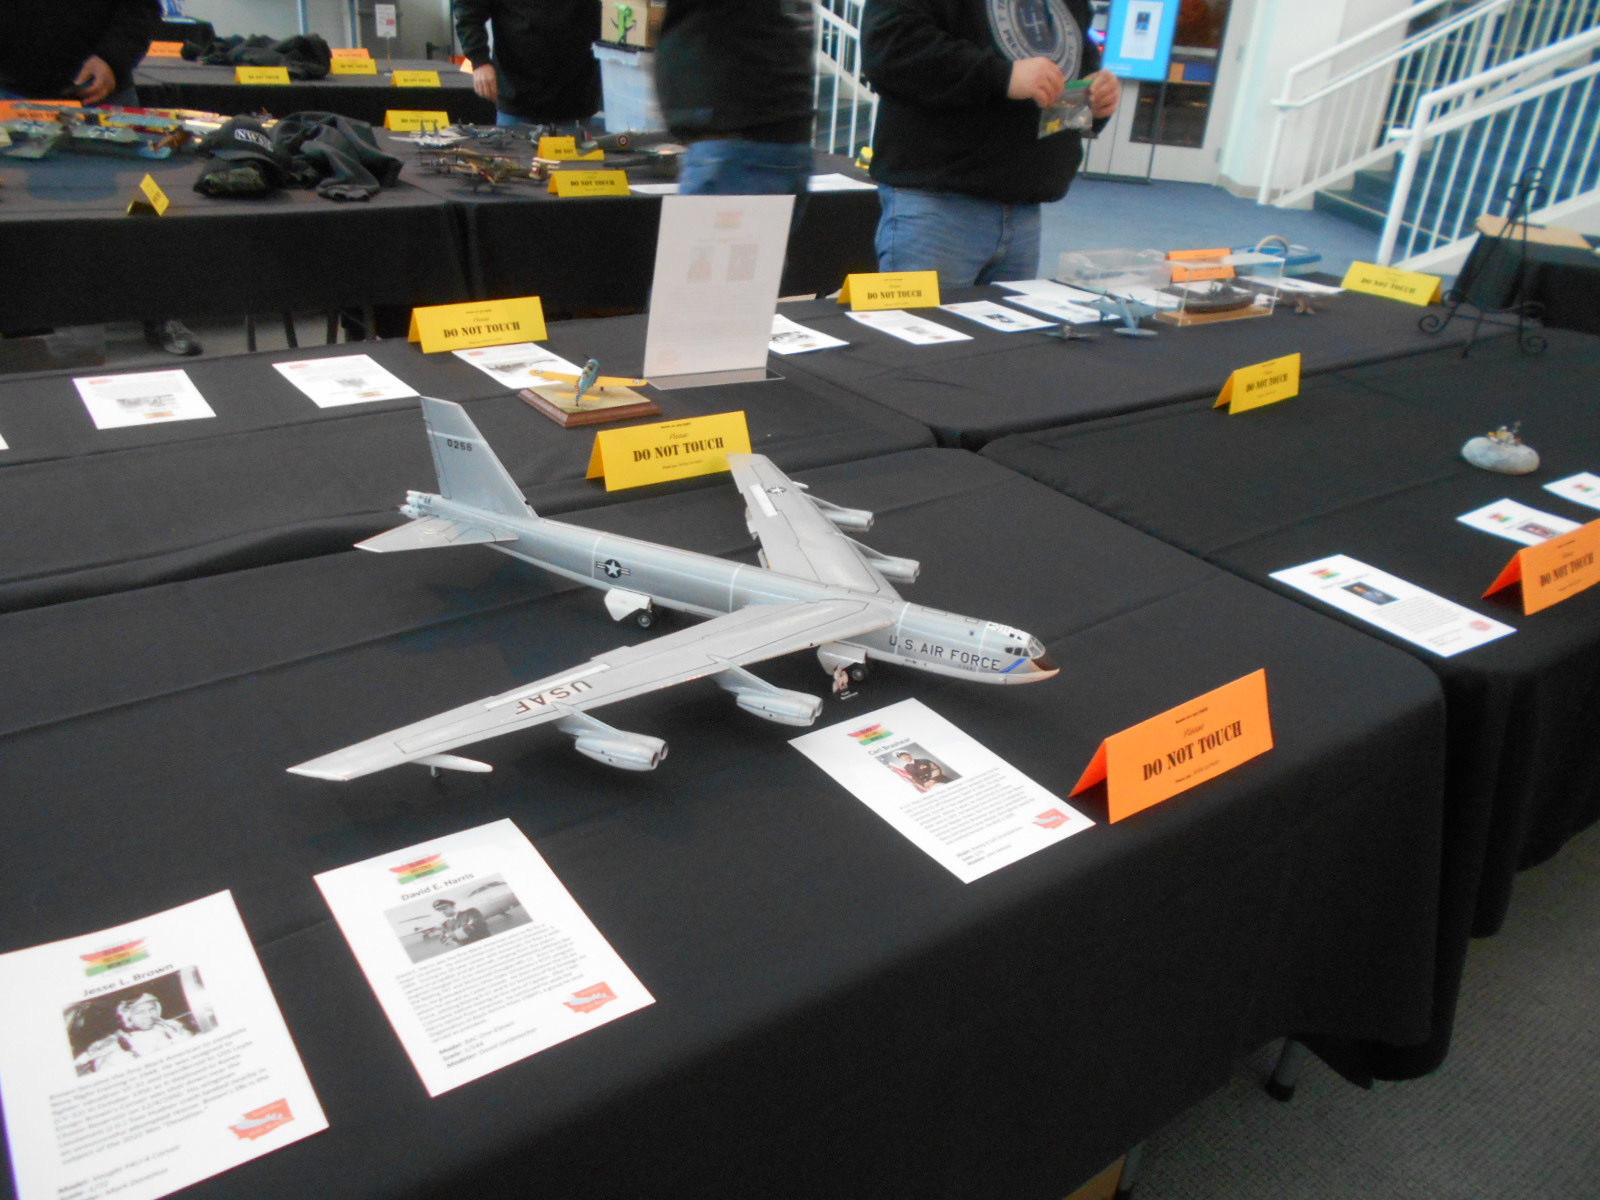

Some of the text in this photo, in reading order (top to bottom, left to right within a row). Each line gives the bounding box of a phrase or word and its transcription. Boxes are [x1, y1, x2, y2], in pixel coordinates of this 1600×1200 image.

[867, 290, 923, 300] DO NOT TOUCH
[443, 321, 521, 339] DO NOT TOUCH
[1246, 373, 1289, 392] DO NOT TOUCH
[633, 437, 725, 462] DO NOT TOUCH
[1540, 572, 1552, 587] DO
[1553, 564, 1568, 581] NOT
[1569, 552, 1594, 574] TOUCH
[920, 642, 944, 658] AIR
[950, 649, 1001, 671] FORCE
[515, 680, 593, 715] USAF
[868, 747, 882, 756] Carl
[1142, 758, 1163, 781] DO
[1166, 743, 1195, 770] NOT
[1198, 720, 1242, 755] TOUCH
[401, 886, 431, 901] David
[444, 873, 475, 886] Harris
[83, 982, 116, 997] Jesse
[133, 964, 174, 981] Brown
